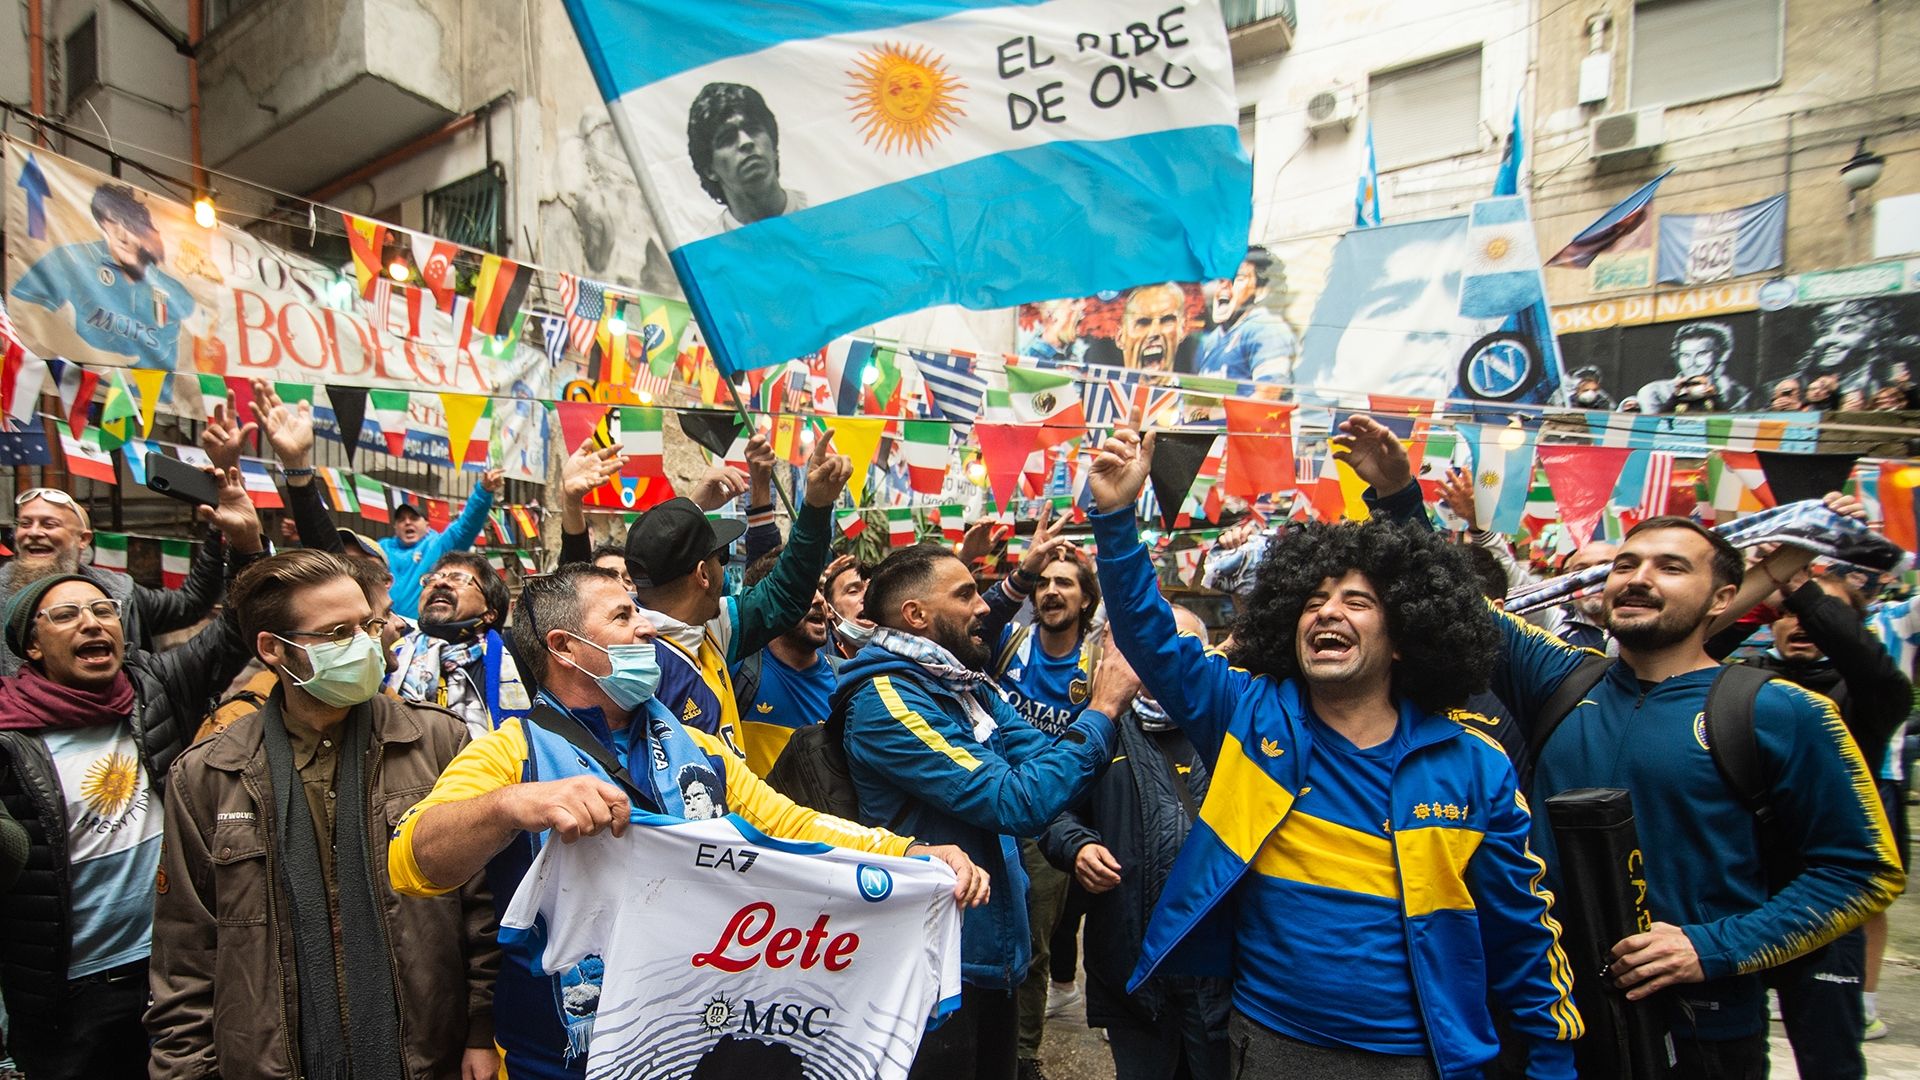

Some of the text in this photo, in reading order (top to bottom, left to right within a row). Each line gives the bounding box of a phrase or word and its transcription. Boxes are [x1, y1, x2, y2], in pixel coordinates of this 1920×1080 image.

[997, 35, 1055, 79] EL
[1007, 81, 1066, 130] DE
[1623, 295, 1653, 320] DI
[86, 307, 160, 349] Mars
[1479, 347, 1516, 391] N
[1007, 690, 1071, 726] QATAR
[1018, 712, 1066, 736] IRWAYS
[695, 843, 760, 873] EA7
[691, 901, 861, 974] Lete
[737, 999, 831, 1038] MSC
